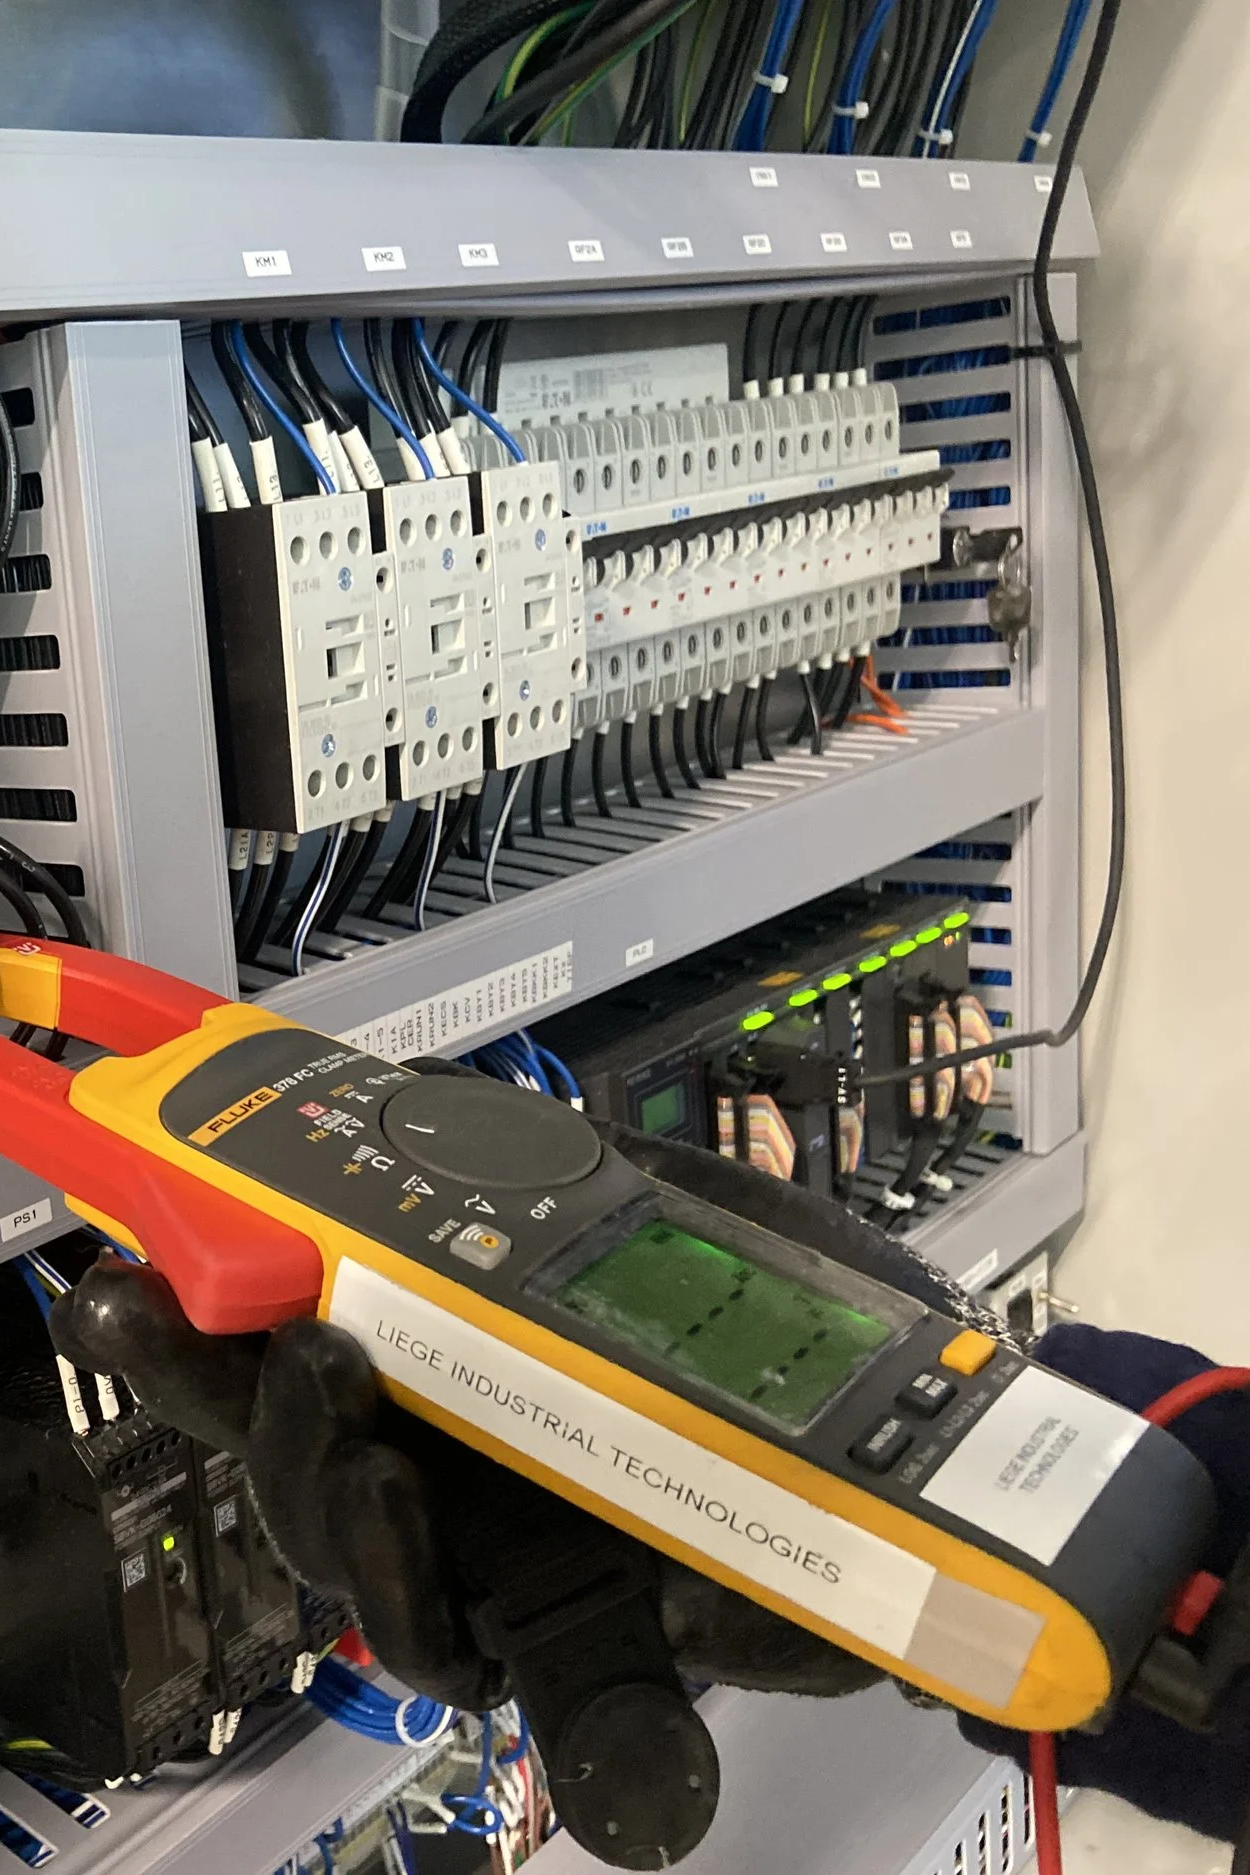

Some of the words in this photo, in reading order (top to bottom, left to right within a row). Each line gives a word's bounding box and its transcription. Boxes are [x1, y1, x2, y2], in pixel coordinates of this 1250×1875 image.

[255, 256, 277, 268] KM1
[373, 251, 395, 263] KM2
[468, 247, 488, 259] KM3
[390, 1026, 398, 1054] K1A
[207, 1090, 274, 1134] FLUKE
[295, 1068, 315, 1083] FC
[313, 1108, 343, 1126] FIELD
[305, 1128, 330, 1142] Hz
[397, 1192, 422, 1213] mV
[530, 1196, 558, 1220] OFF
[13, 1208, 38, 1229] PS1
[428, 1218, 462, 1244] SAVE
[376, 1319, 445, 1370] LIEGE
[450, 1361, 600, 1458] INDUSTRIAL
[610, 1444, 843, 1585] TECHNOLOGIES
